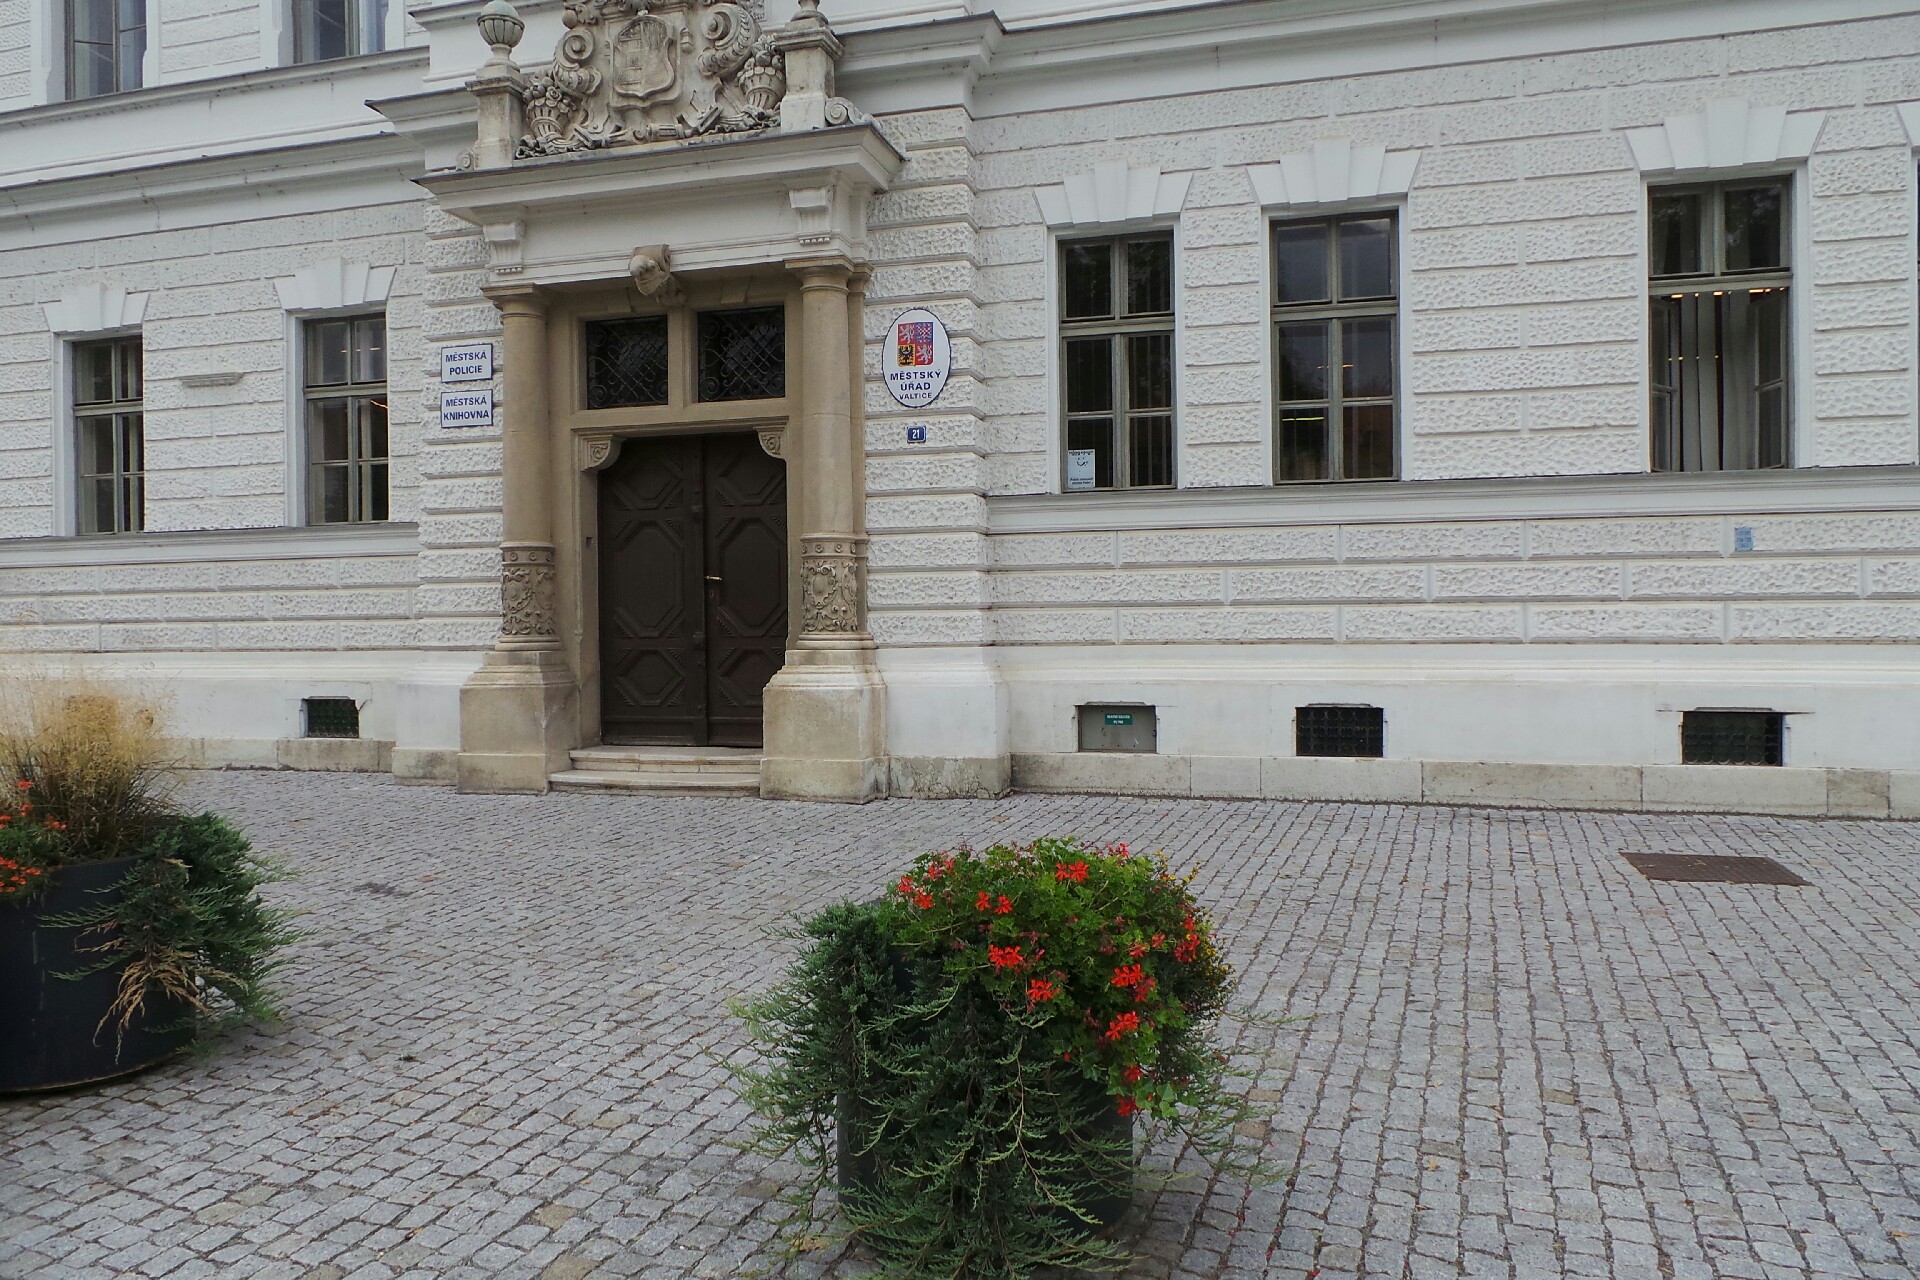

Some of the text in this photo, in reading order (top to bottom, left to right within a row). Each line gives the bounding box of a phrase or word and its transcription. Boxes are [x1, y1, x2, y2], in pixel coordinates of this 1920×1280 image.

[445, 350, 487, 362] MĚSTSKÁ
[449, 365, 483, 375] POLICIE
[890, 369, 942, 380] MĚSTSKÝ
[900, 381, 931, 391] ÚŘAD
[445, 395, 487, 407] MĚSTSKÁ
[899, 392, 933, 400] VALTICE
[443, 410, 490, 421] KNIHOVNA
[912, 429, 920, 439] 21
